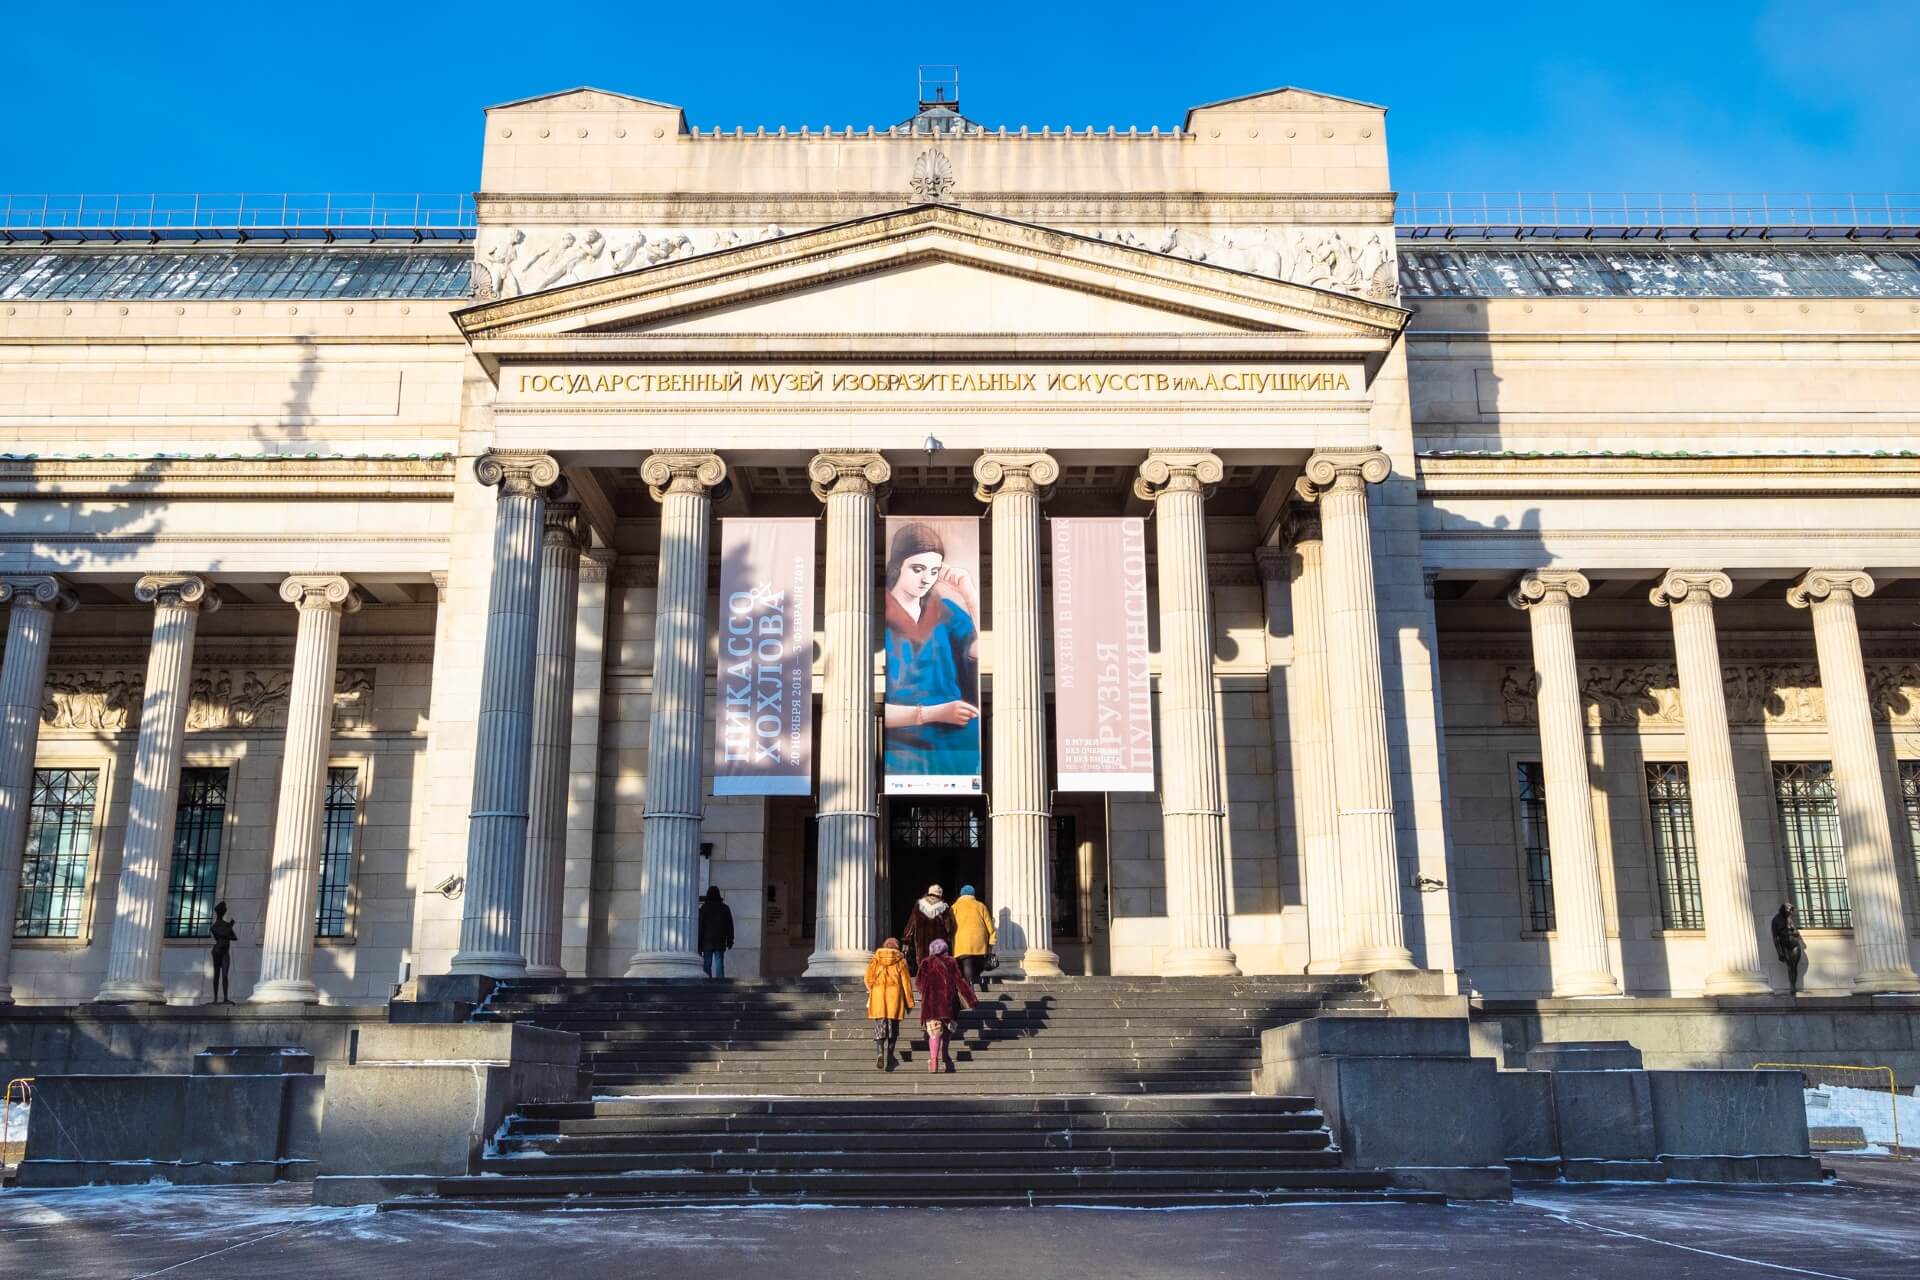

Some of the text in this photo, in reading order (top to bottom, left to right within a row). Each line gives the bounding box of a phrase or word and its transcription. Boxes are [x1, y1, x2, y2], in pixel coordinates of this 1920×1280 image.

[519, 372, 743, 393] ГОСУДАРСТВЕННЫЙ
[750, 372, 825, 394] МУЗЕЙ
[832, 373, 1037, 393] ИЗОБРАЗИТЕЛЬНЫХ
[1047, 373, 1169, 394] ИСКУССТВ
[793, 586, 803, 643] ФЕВРАЛЯ
[1056, 518, 1074, 688] МУЗЕЙ В ПОДАРОК
[1121, 518, 1153, 769] ПУШКИНСКОГО
[724, 591, 754, 763] ПИКАССО
[755, 590, 785, 764] ХОХЛОВА
[792, 669, 802, 696] 2018
[791, 699, 801, 750] НОЯБРЯ
[791, 753, 800, 767] 20
